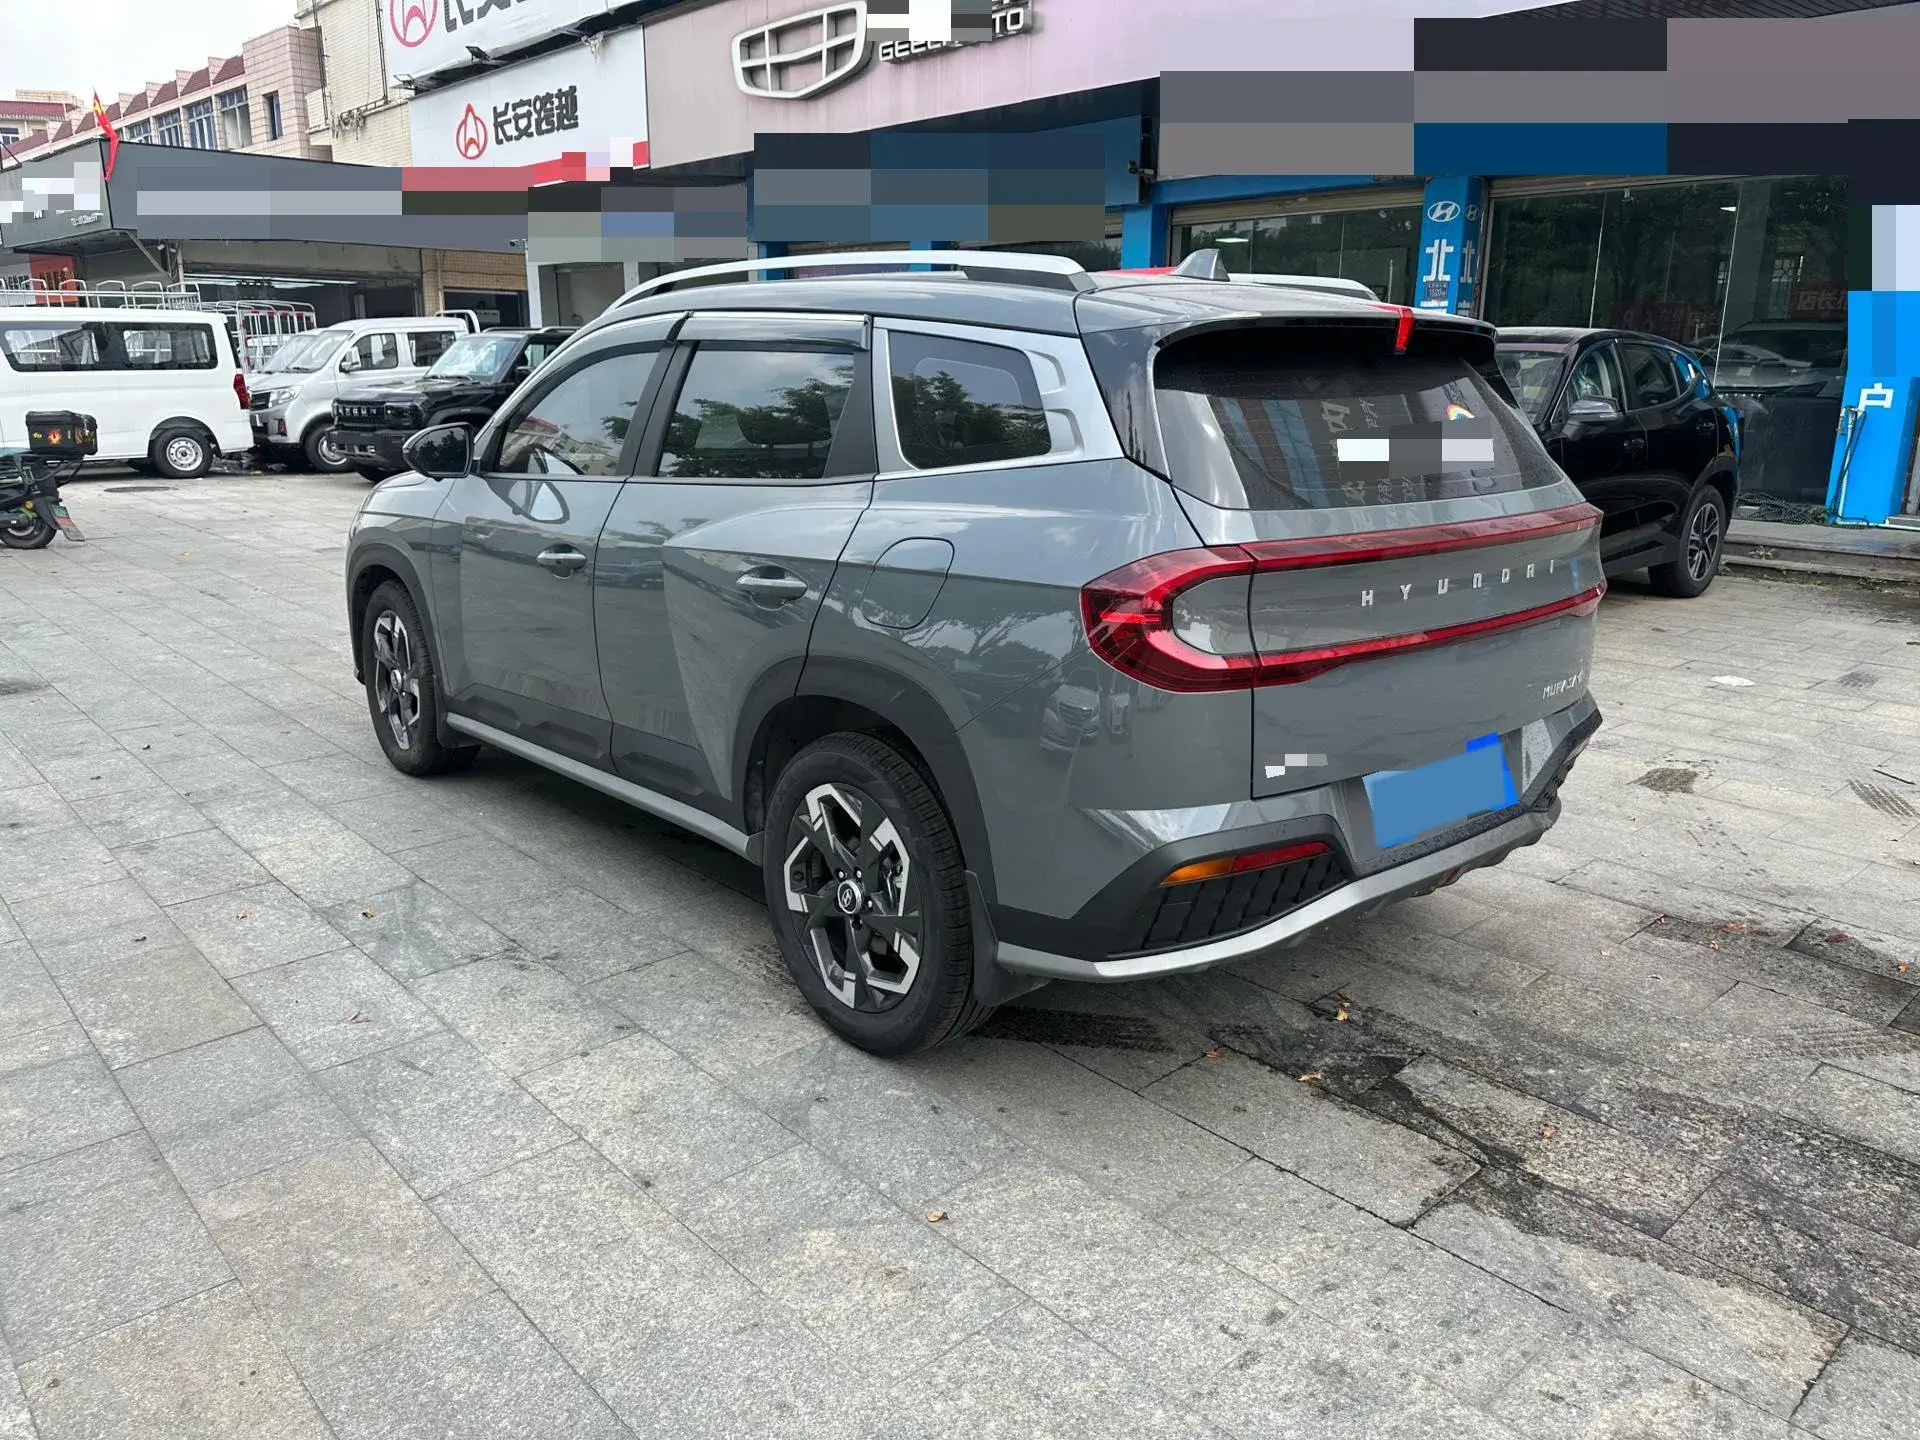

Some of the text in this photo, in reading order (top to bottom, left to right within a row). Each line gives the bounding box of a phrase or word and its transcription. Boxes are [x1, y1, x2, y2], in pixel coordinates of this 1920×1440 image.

[493, 85, 579, 145] 长安跨越
[1361, 559, 1554, 607] HYUNDAI
